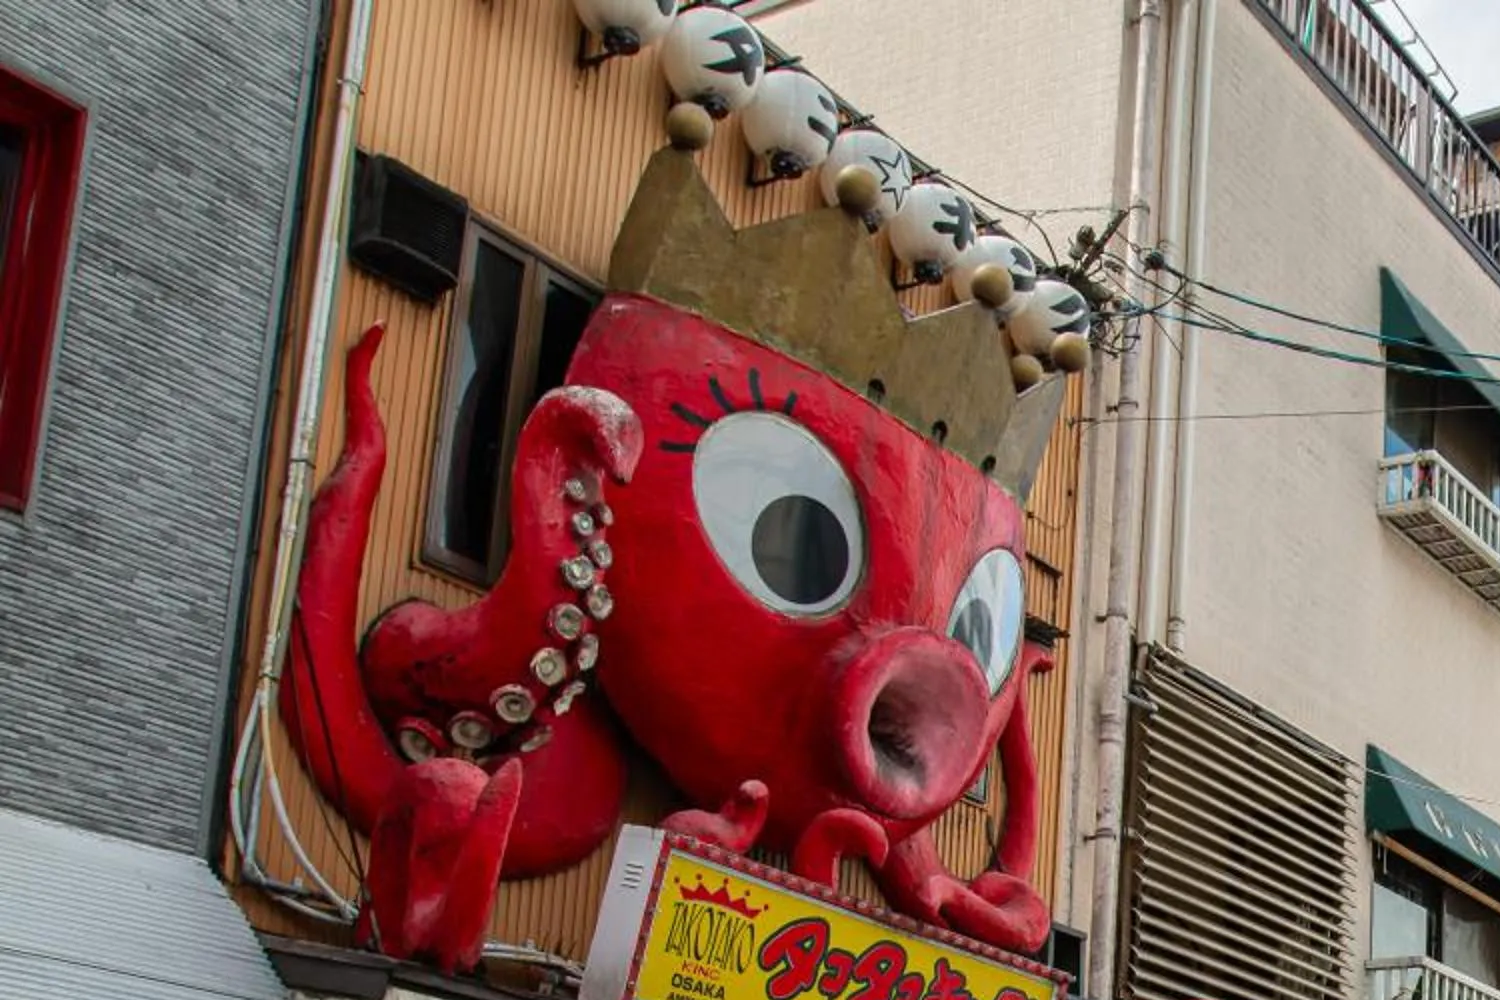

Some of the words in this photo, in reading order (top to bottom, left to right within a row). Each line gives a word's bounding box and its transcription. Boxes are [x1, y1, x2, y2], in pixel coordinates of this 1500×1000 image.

[665, 901, 755, 974] TAKOTAKO
[681, 960, 720, 980] KING
[671, 973, 725, 1000] OSAKA
